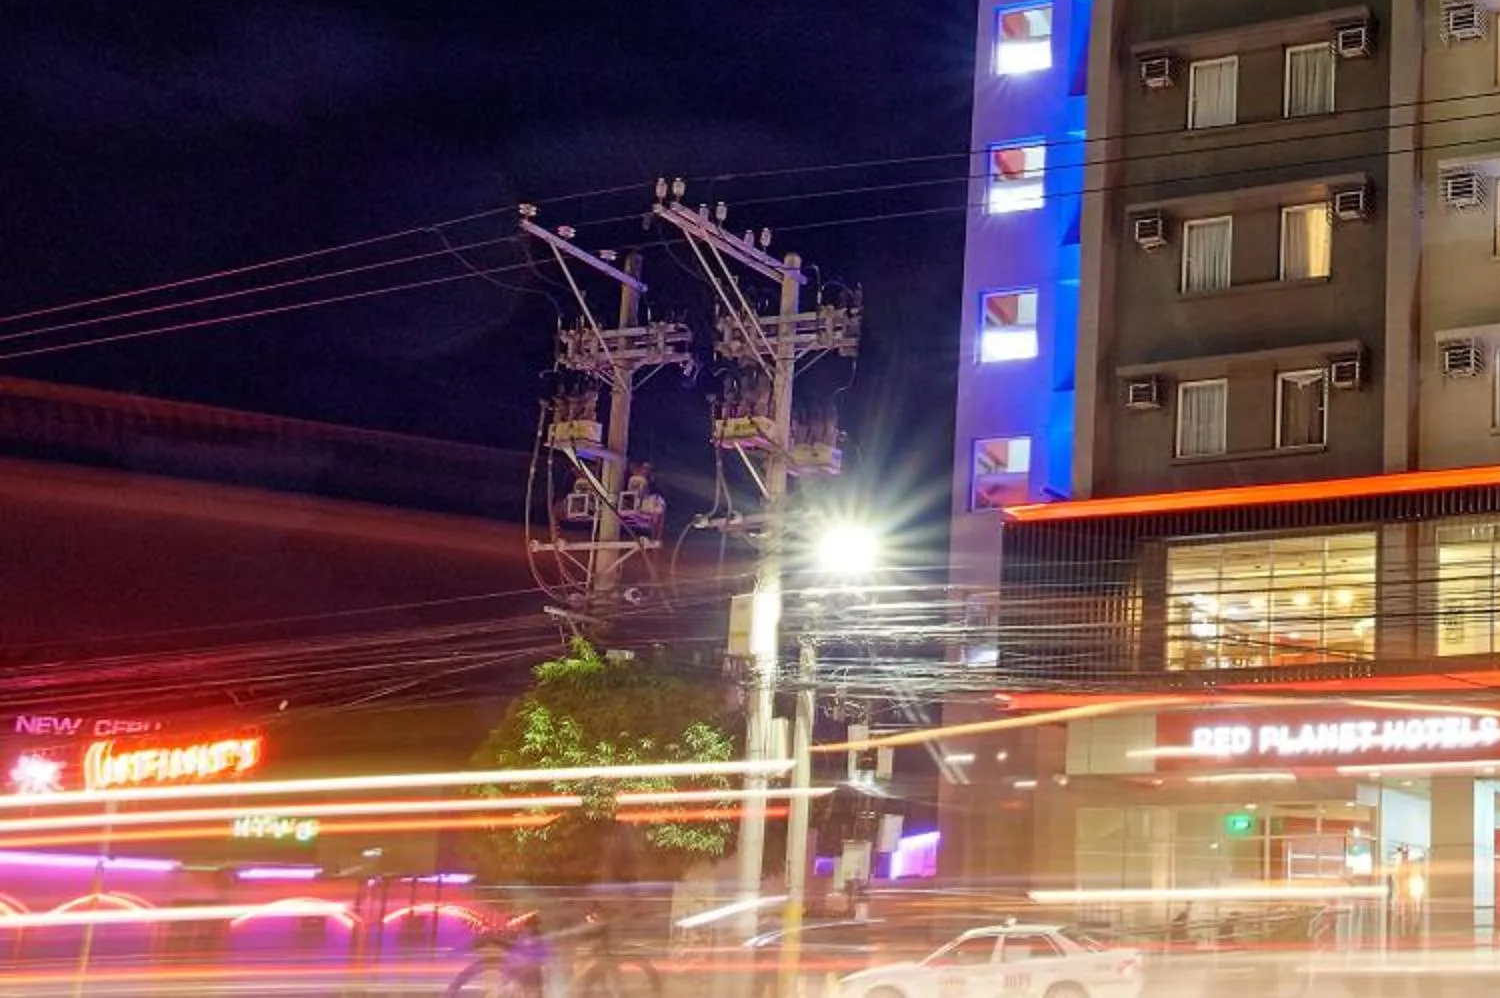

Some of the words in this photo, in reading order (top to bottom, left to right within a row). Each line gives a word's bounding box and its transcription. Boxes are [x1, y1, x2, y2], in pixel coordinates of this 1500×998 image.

[15, 715, 82, 735] NEW
[1192, 726, 1251, 753] RED
[1259, 720, 1376, 755] PLANET
[1383, 717, 1499, 750] HOTELS
